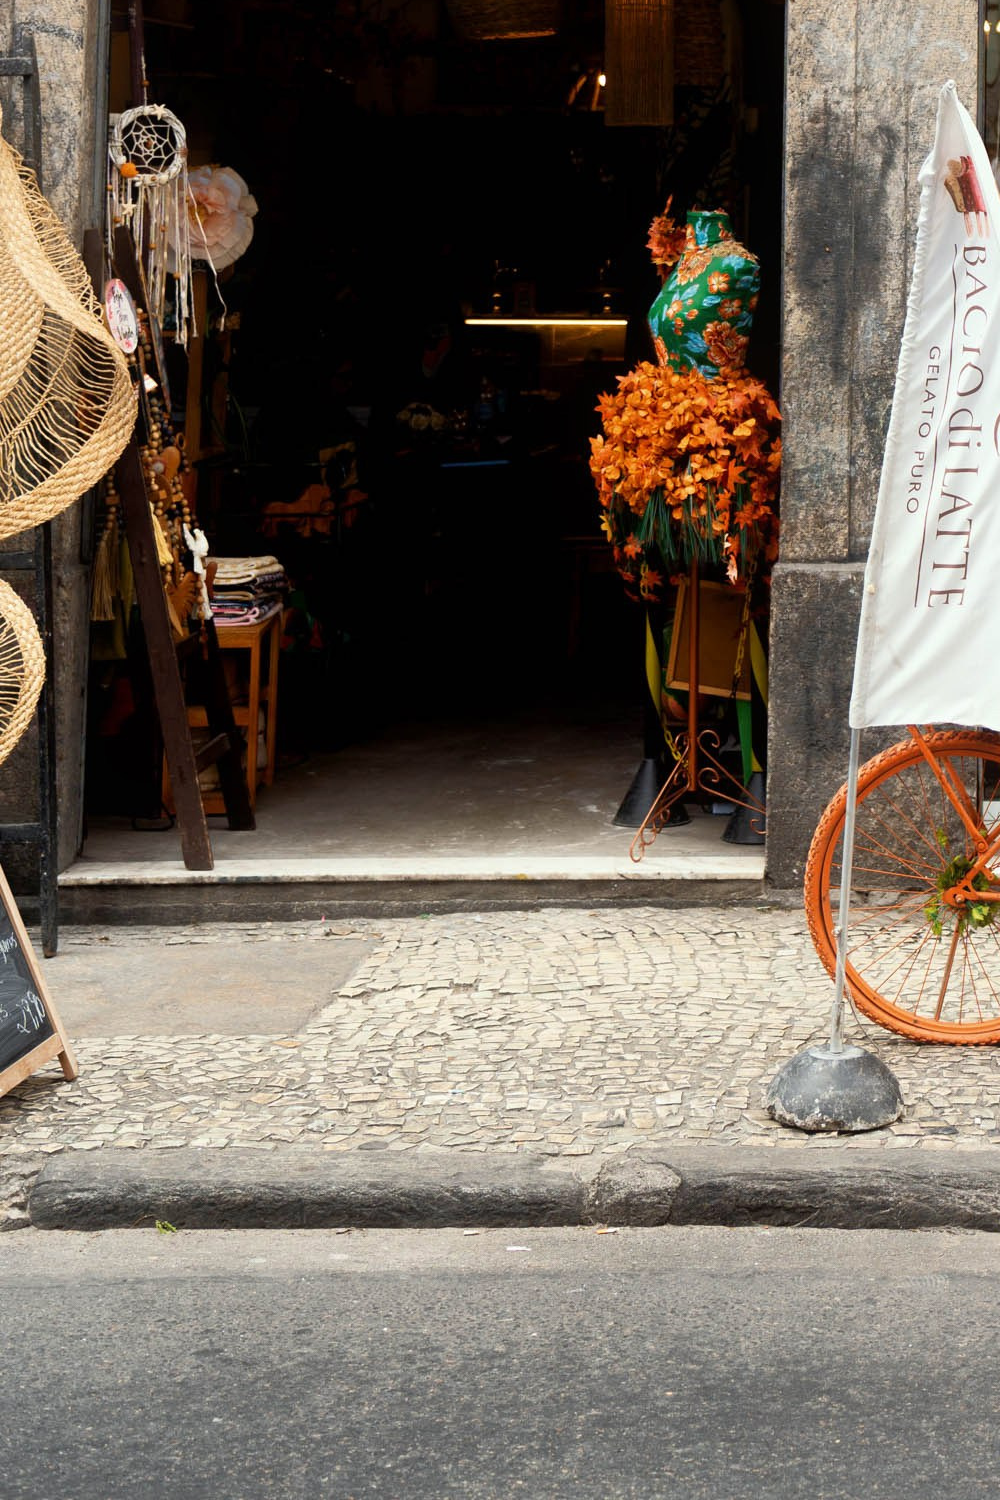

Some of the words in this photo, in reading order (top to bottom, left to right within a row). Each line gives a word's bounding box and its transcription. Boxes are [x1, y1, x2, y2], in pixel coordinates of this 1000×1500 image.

[956, 243, 988, 397] BACIO
[918, 345, 942, 438] GELATO
[949, 407, 983, 450] di
[906, 451, 925, 514] PURO
[927, 465, 980, 608] LATTE
